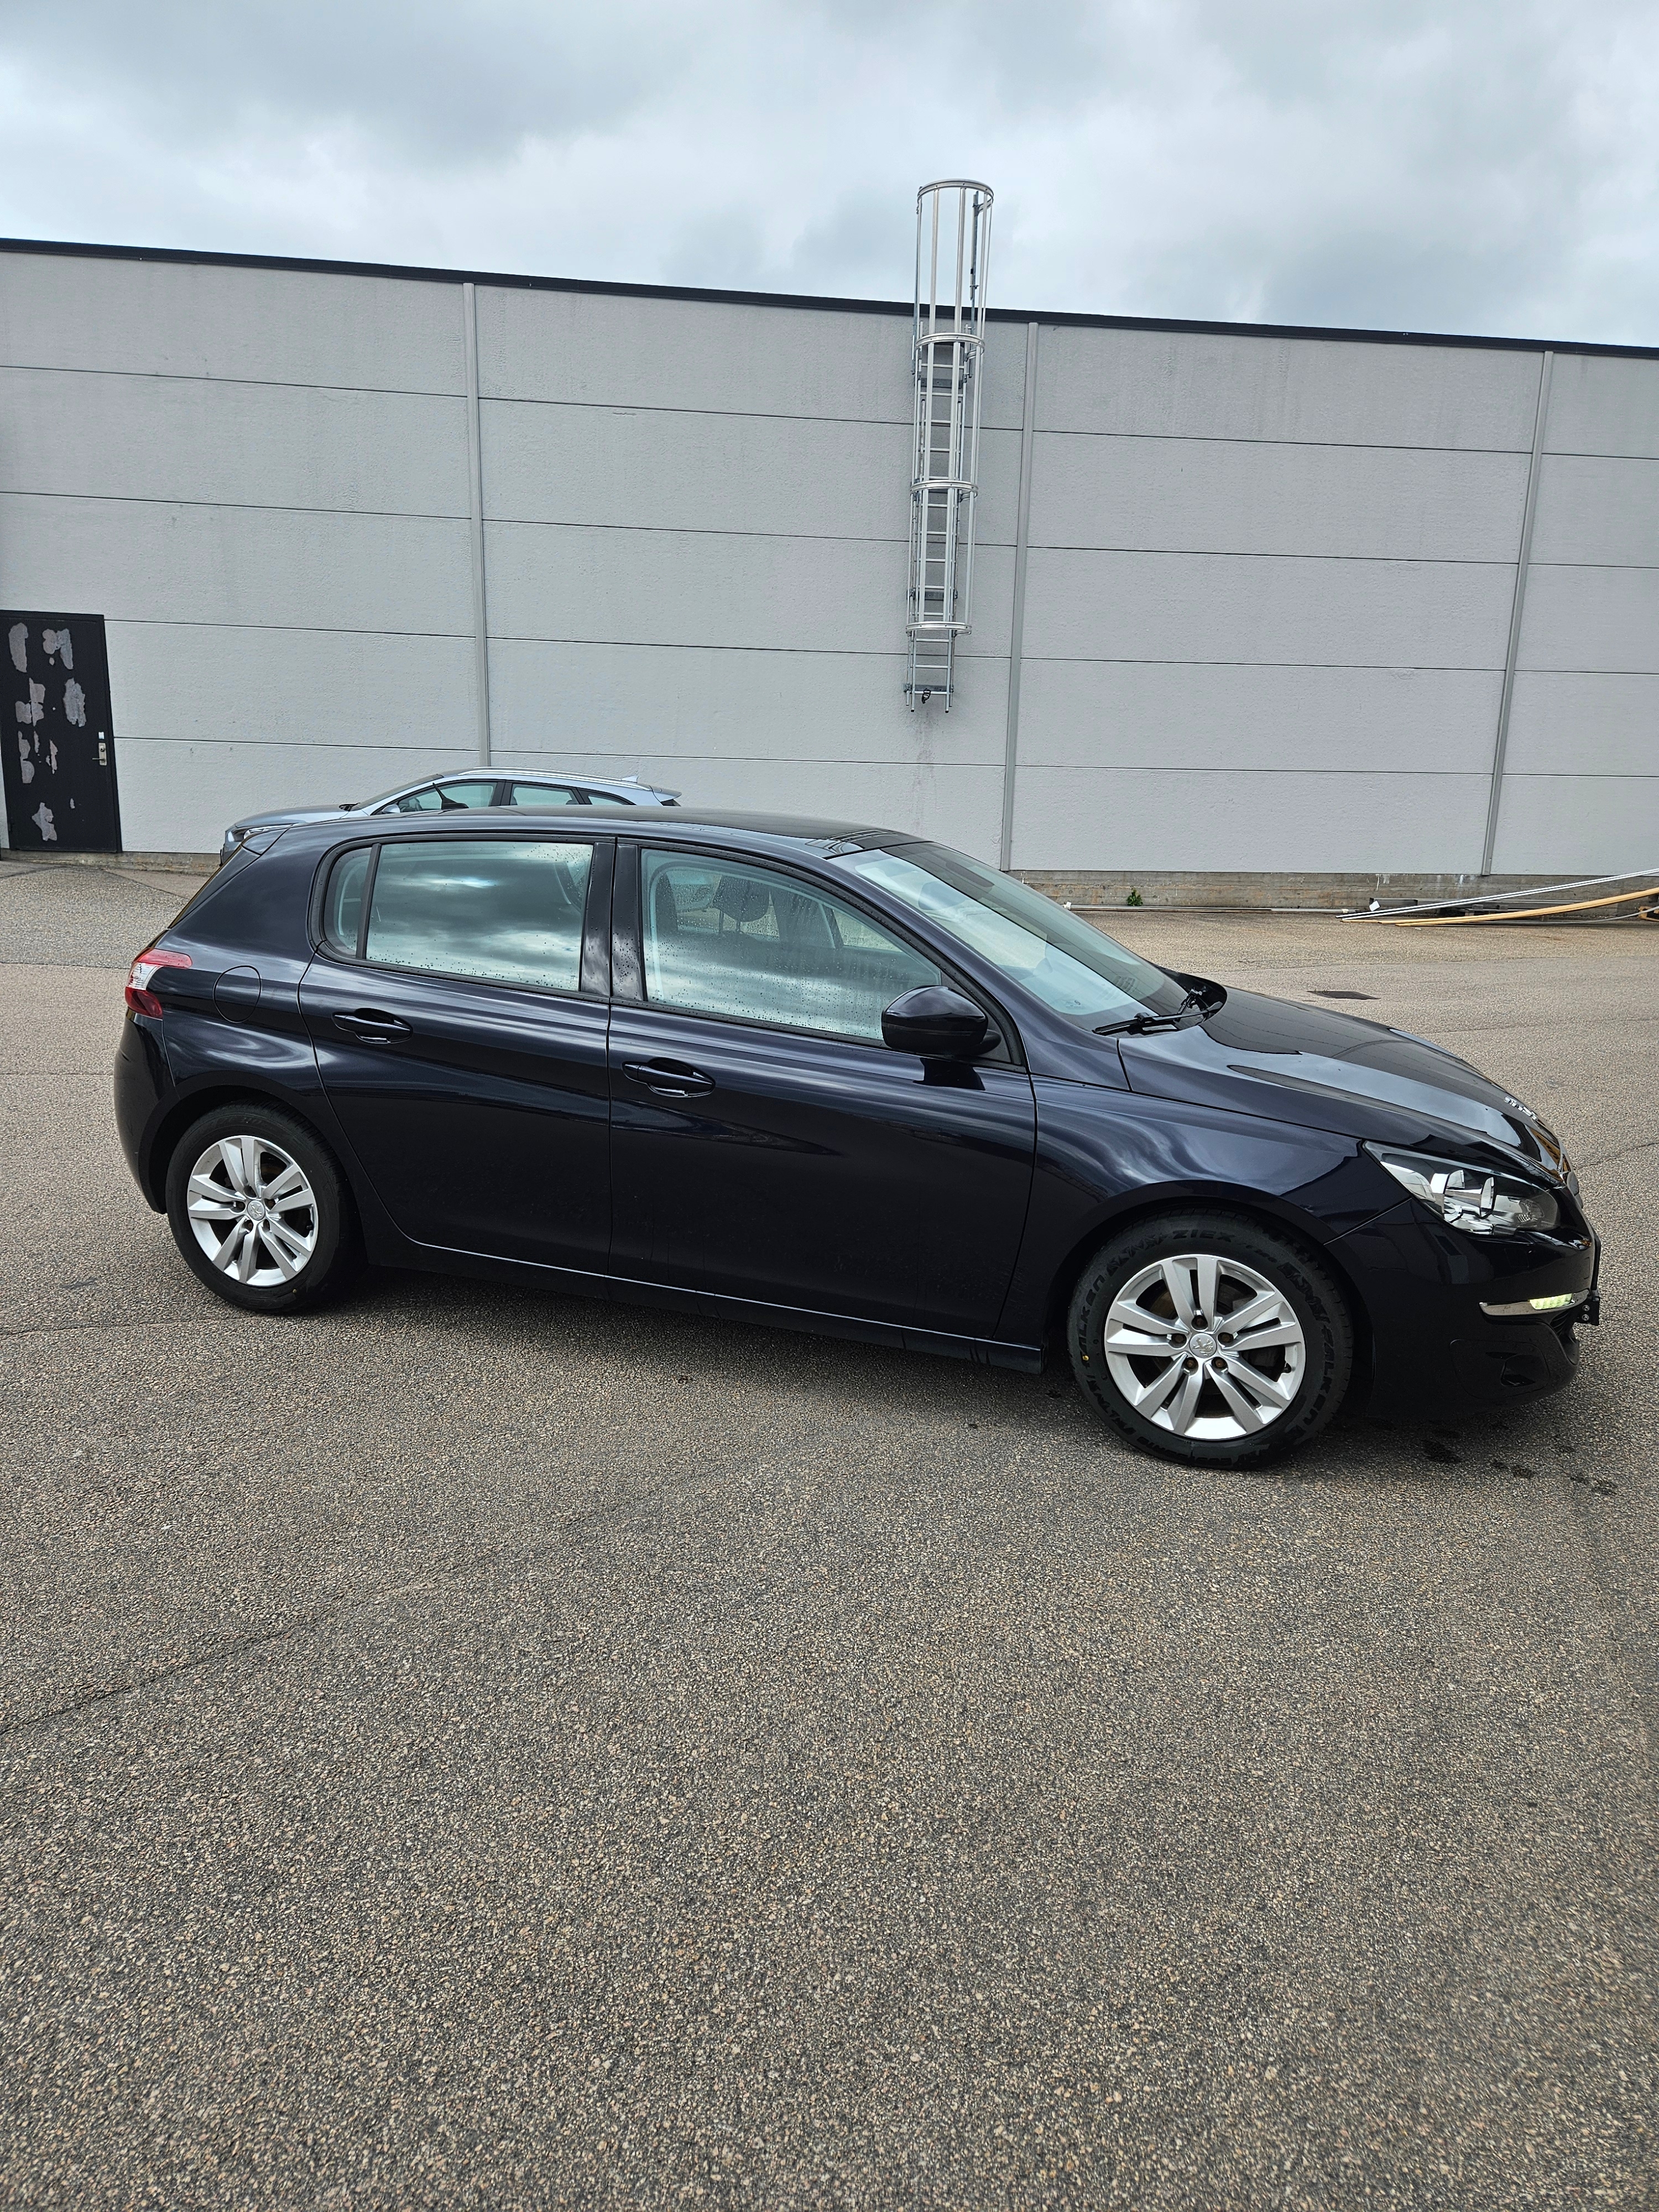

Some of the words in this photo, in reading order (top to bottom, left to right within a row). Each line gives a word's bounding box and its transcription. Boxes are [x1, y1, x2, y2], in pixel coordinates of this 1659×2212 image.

[1172, 1229, 1235, 1243] ZIEX
[1079, 1275, 1105, 1368] FALKEN
[1303, 1324, 1334, 1426] FALKEN
